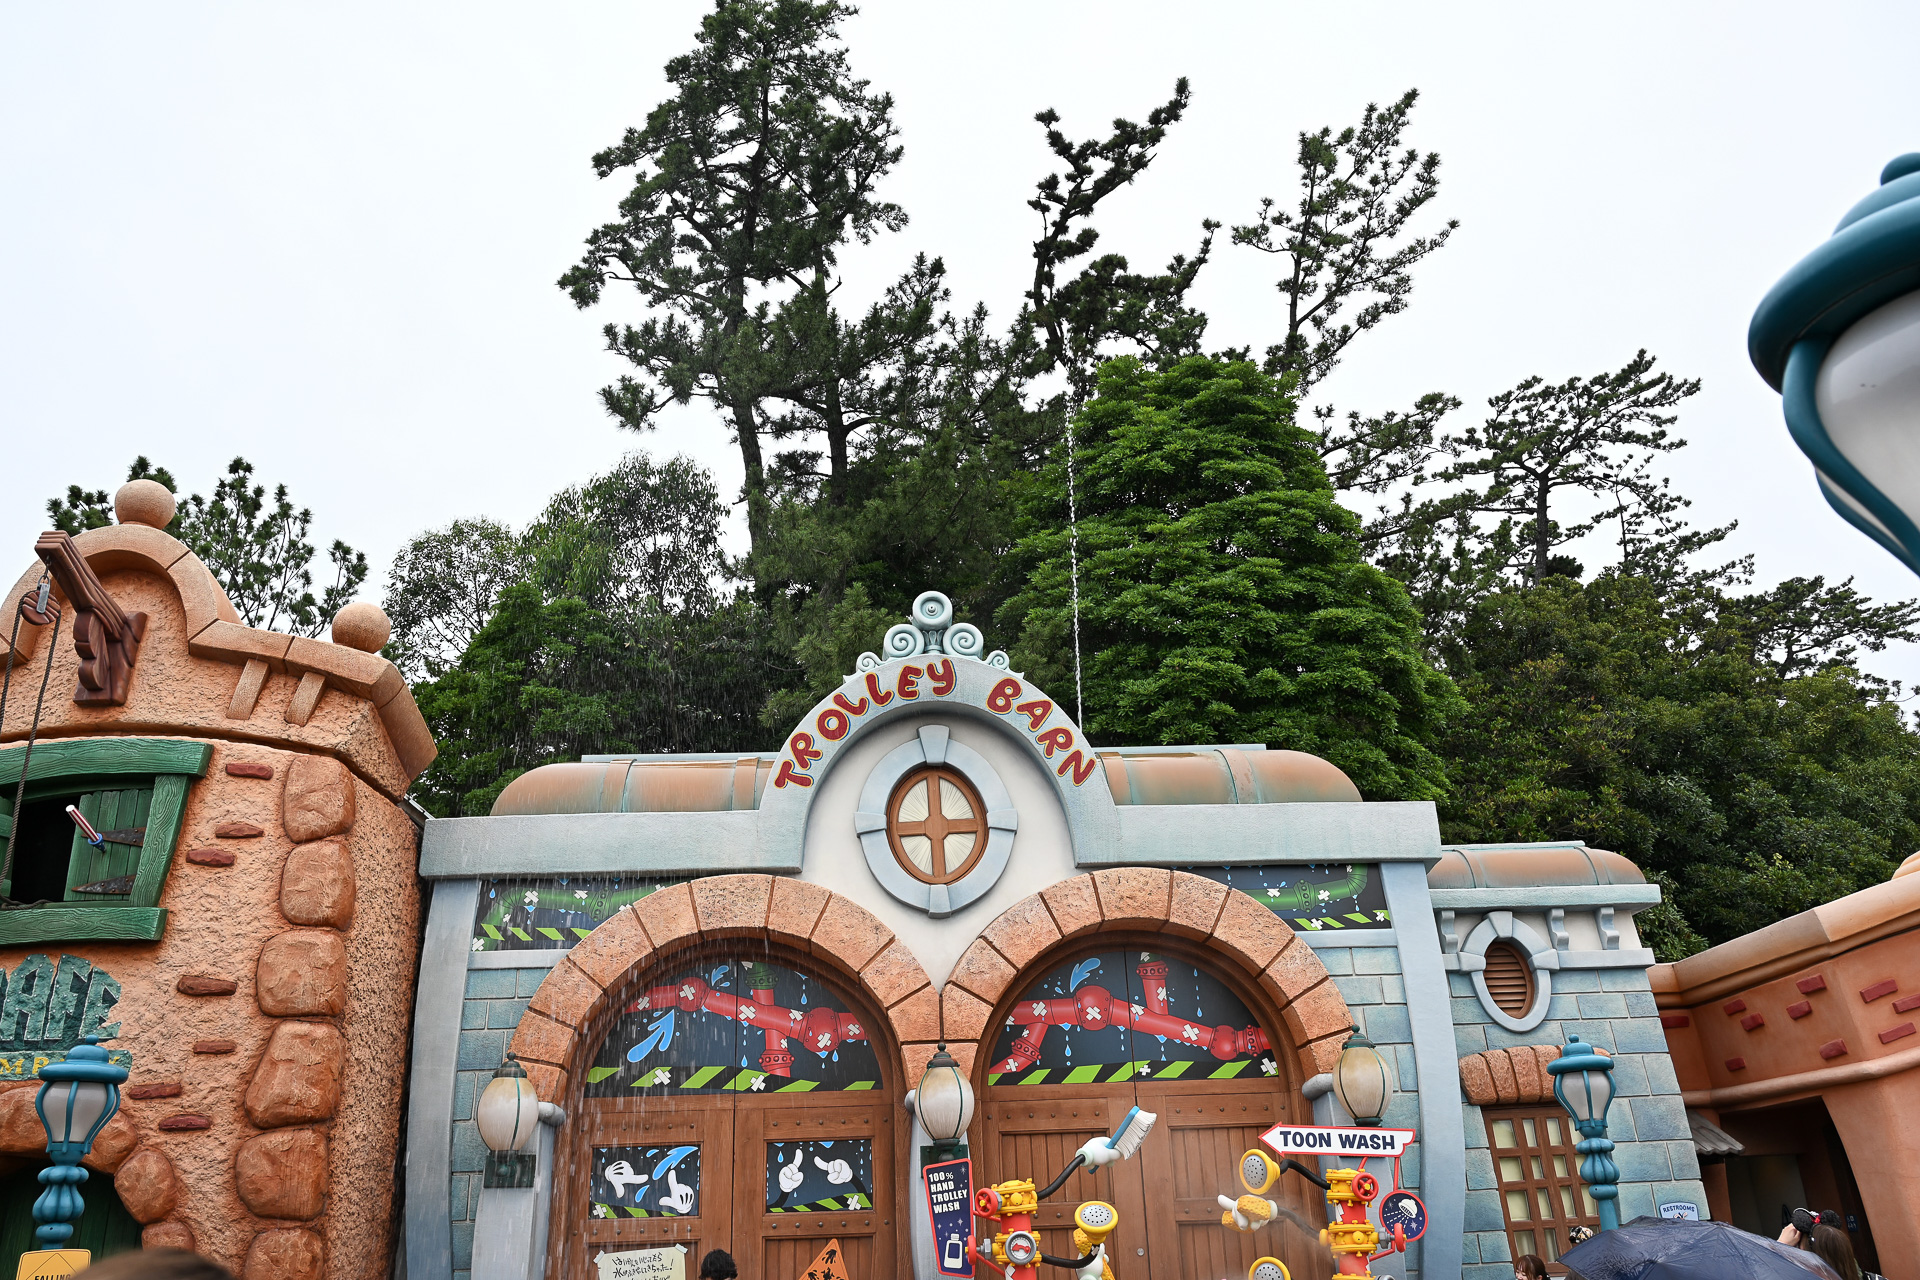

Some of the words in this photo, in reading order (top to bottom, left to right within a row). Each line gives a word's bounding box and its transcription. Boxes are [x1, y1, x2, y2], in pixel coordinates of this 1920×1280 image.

[774, 658, 956, 788] TROLLEY
[986, 677, 1097, 787] BARN
[0, 953, 122, 1040] AFE
[1280, 1130, 1332, 1148] TOON
[1338, 1133, 1395, 1150] WASH
[928, 1172, 953, 1182] 100%
[930, 1181, 954, 1192] HAND
[932, 1189, 967, 1203] TROLLEY
[933, 1201, 960, 1213] WASH
[1662, 1204, 1695, 1212] RESTROOMS
